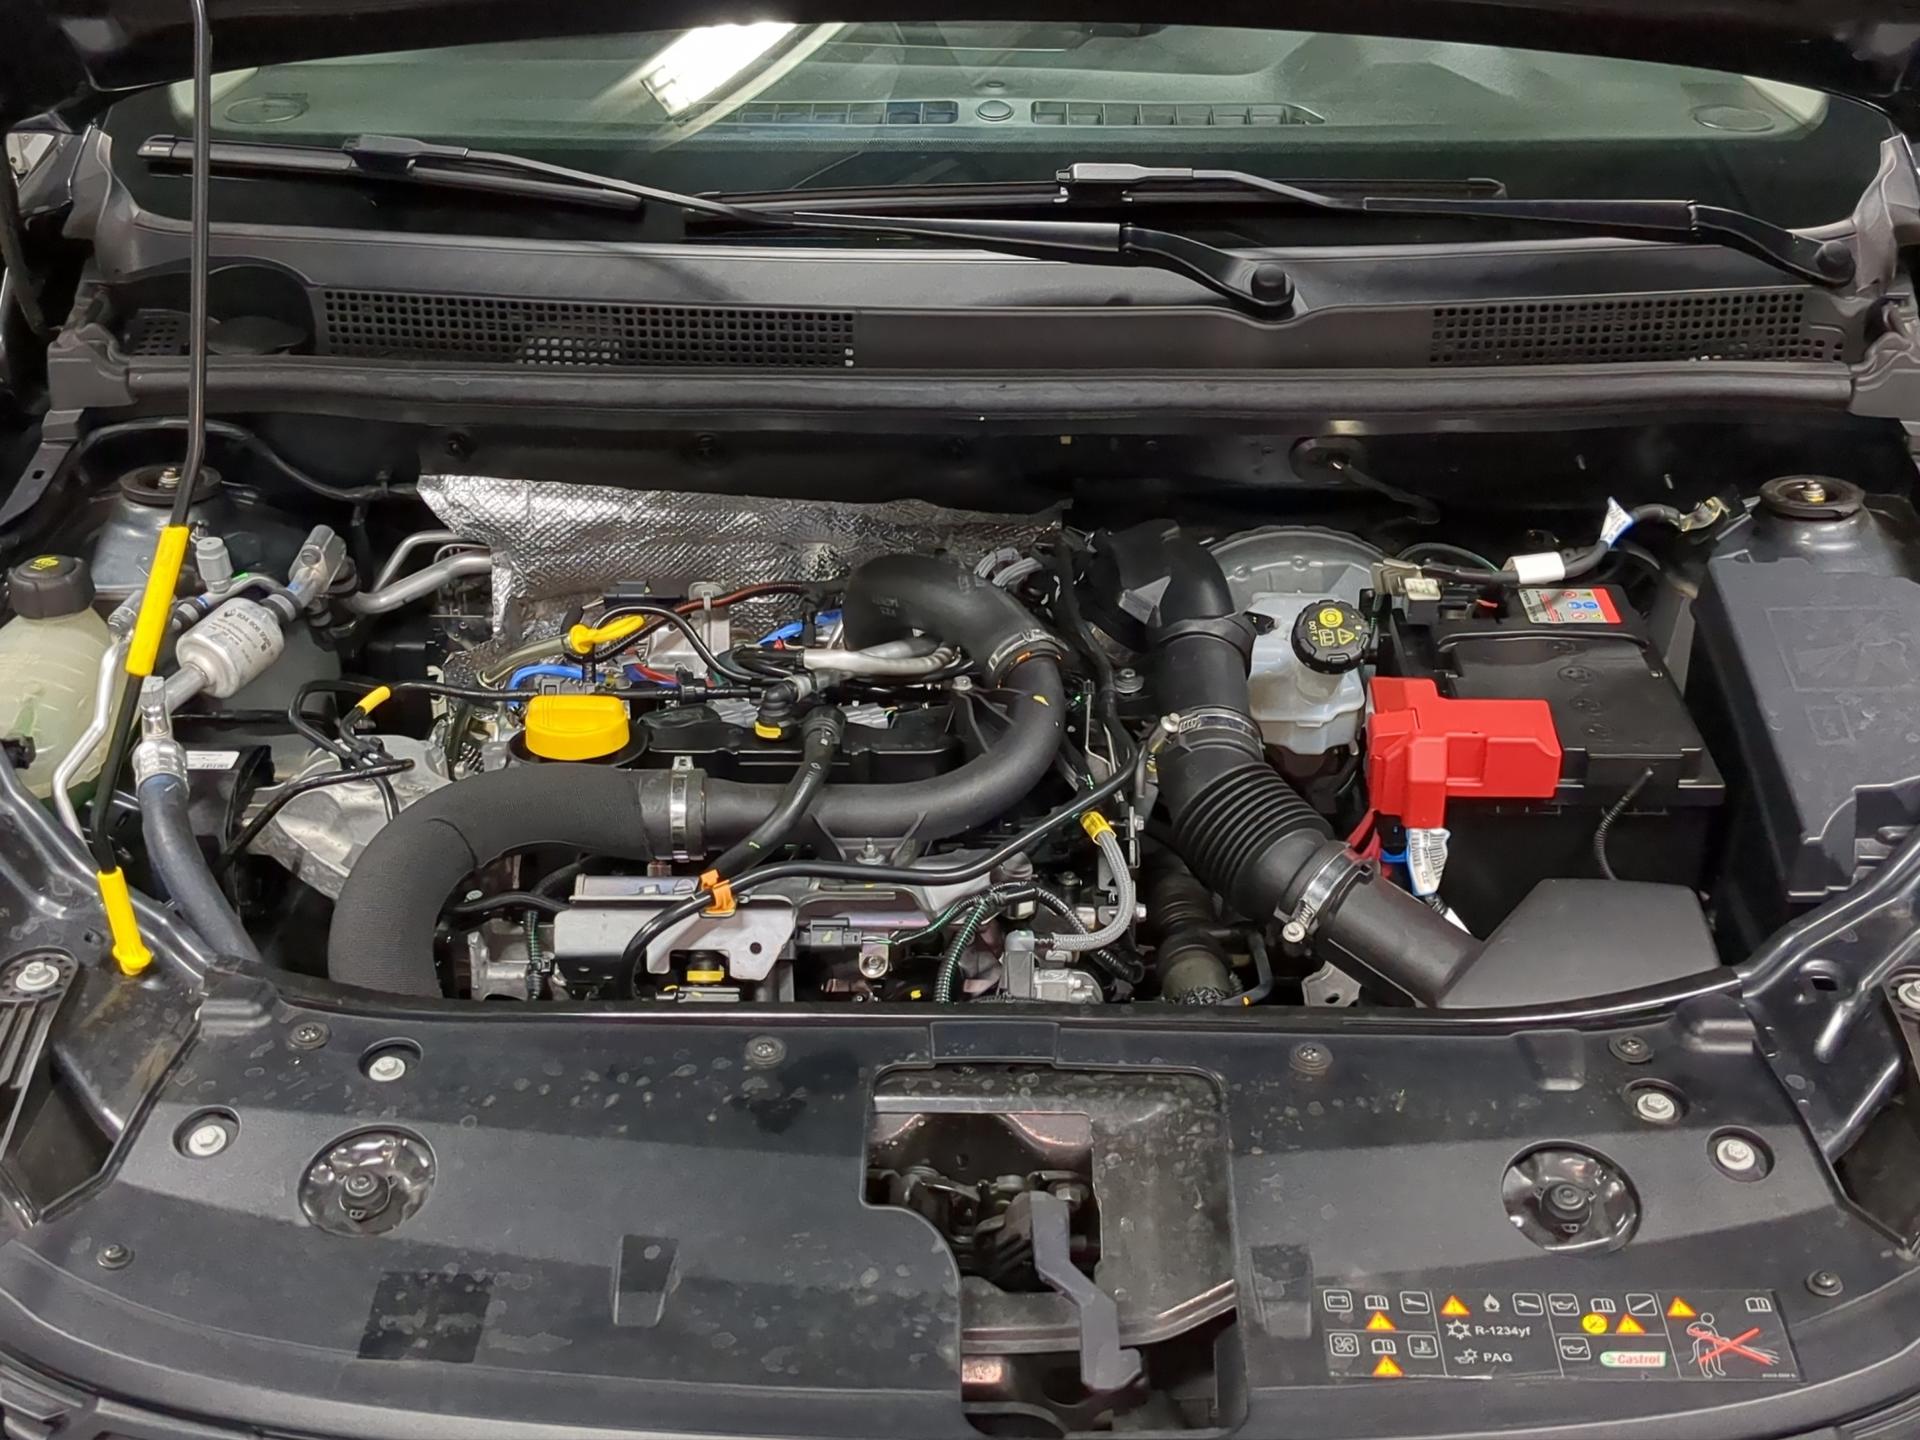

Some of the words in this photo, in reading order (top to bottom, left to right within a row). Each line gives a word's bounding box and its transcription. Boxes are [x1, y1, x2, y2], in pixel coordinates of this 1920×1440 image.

[1308, 620, 1318, 634] DOT
[1475, 1325, 1531, 1338] R-1234yf
[1483, 1352, 1513, 1363] PAG
[1617, 1353, 1661, 1366] Castrol
